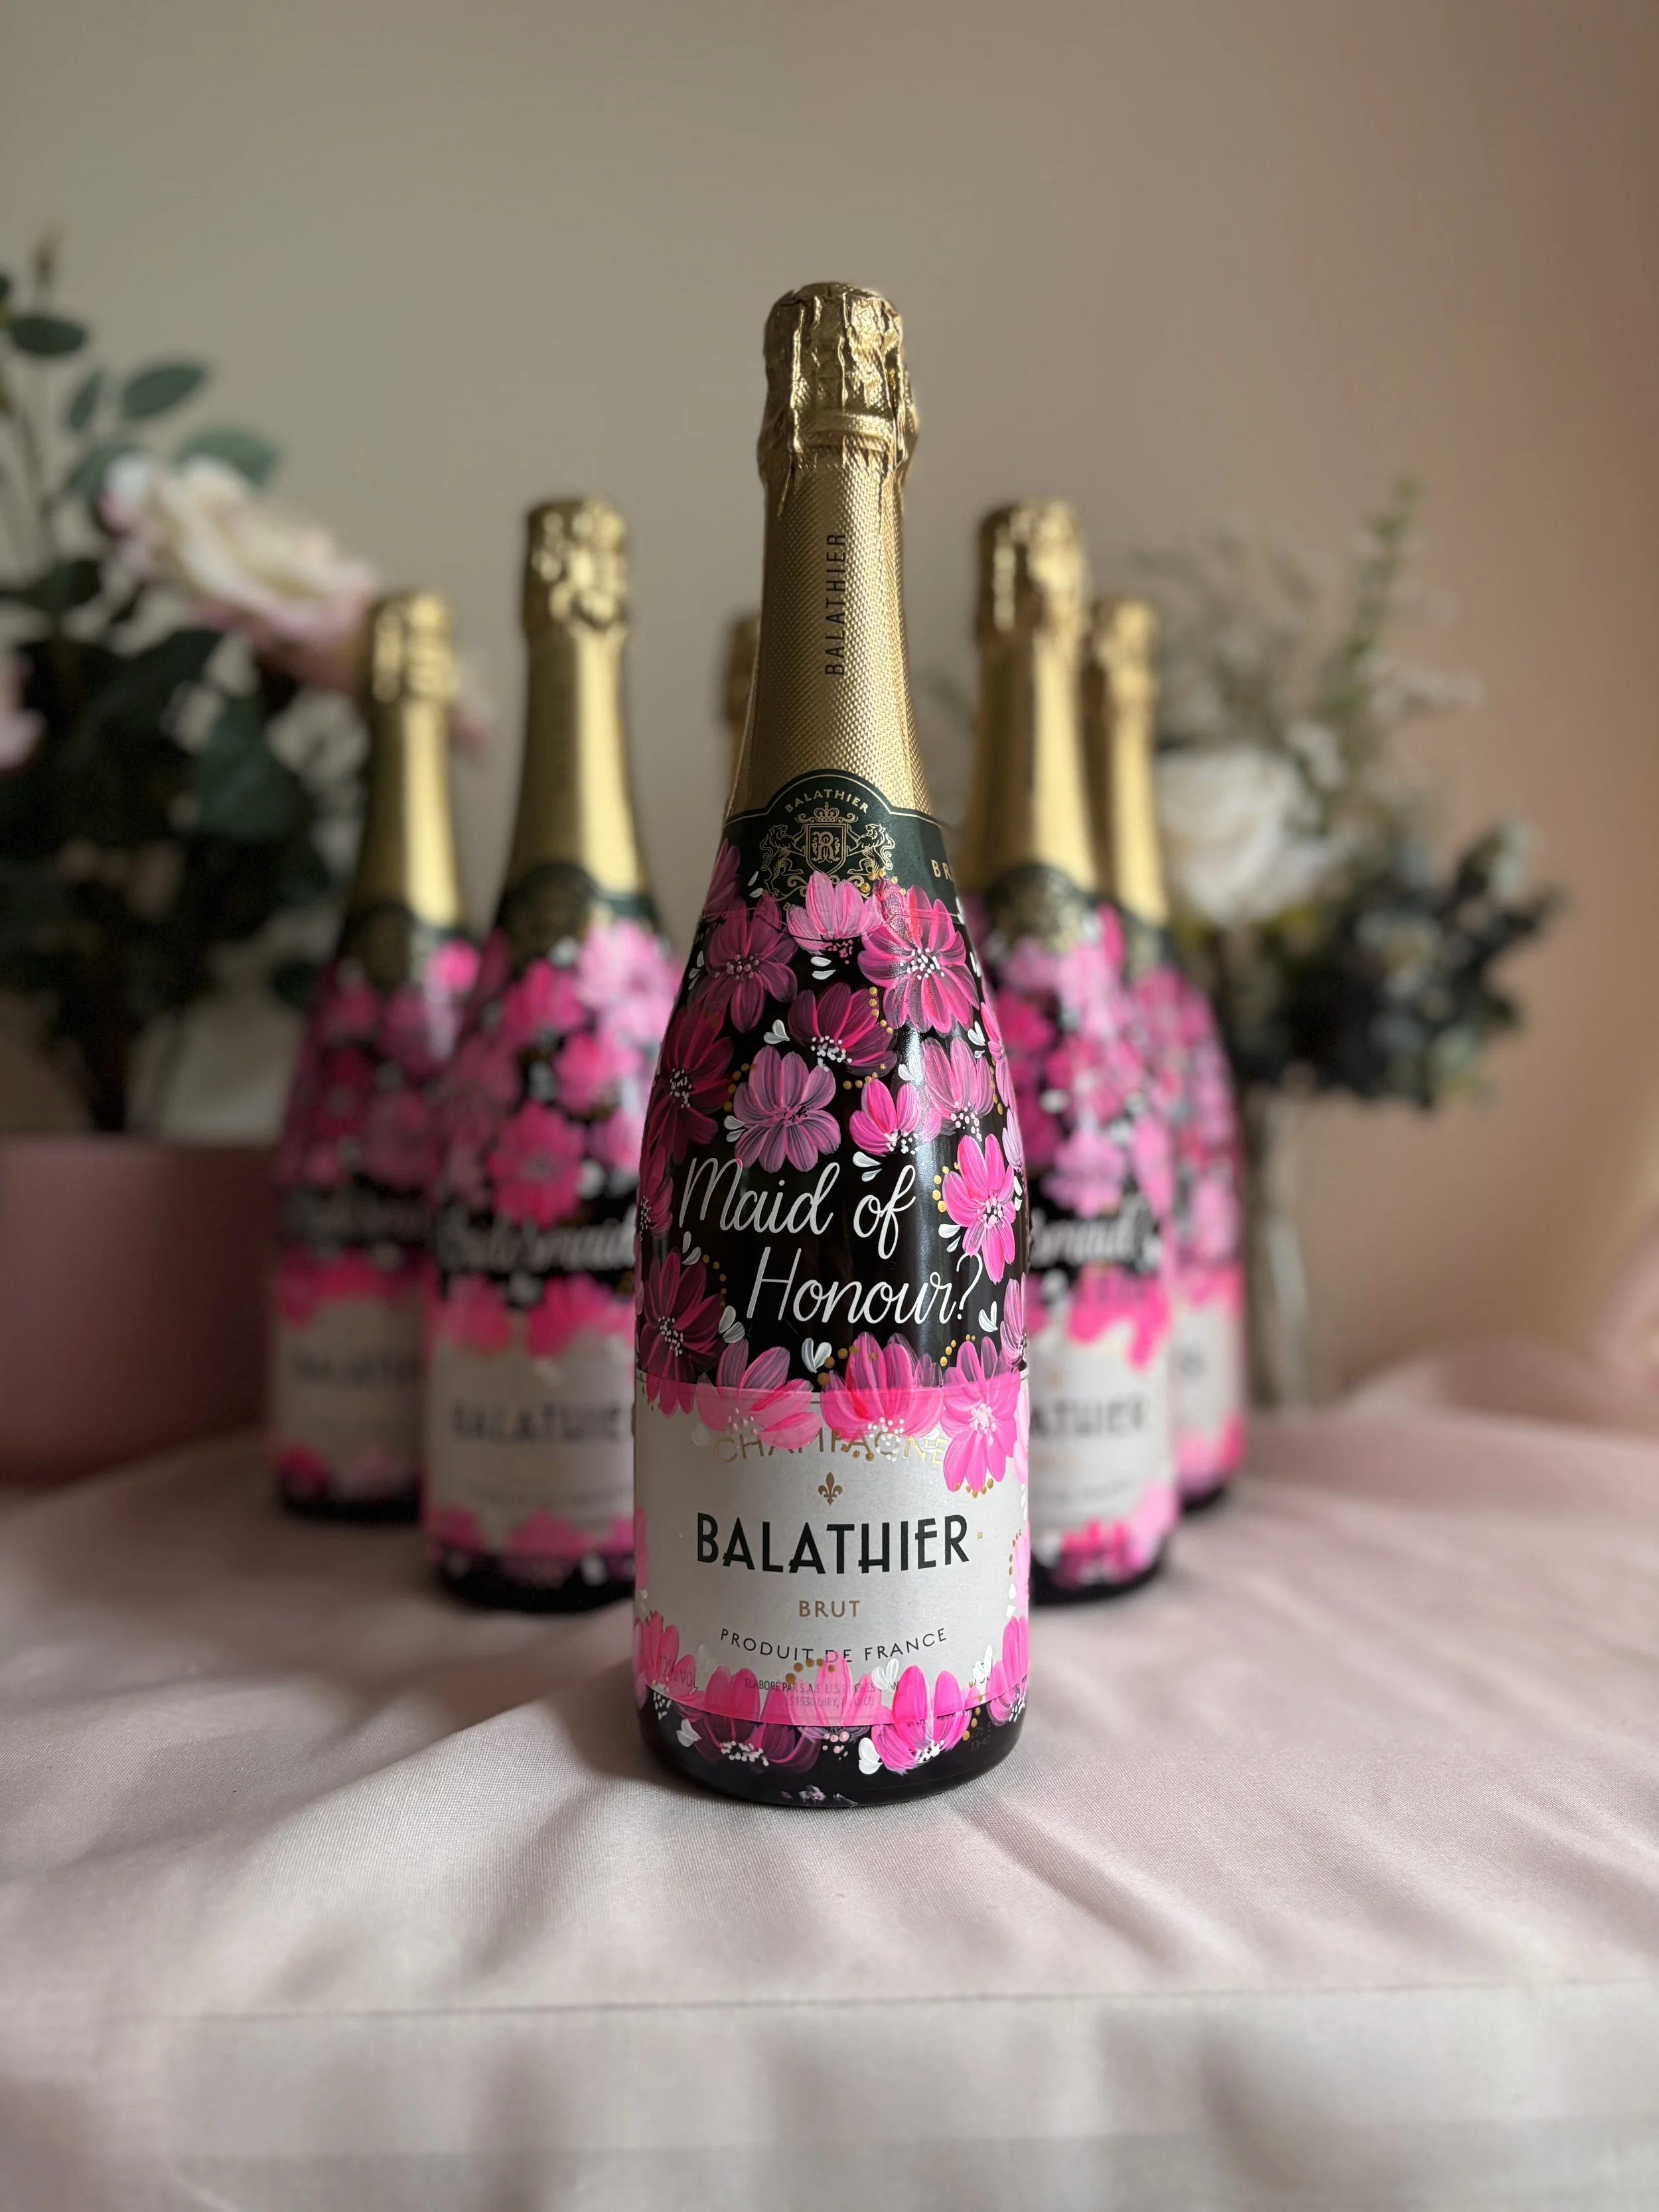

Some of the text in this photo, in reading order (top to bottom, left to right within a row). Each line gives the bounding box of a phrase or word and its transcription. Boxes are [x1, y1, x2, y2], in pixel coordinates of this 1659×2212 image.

[826, 533, 846, 676] BALATHIER
[784, 788, 869, 814] BALATHIER
[679, 1157, 916, 1259] Maid of
[747, 1246, 983, 1325] Honour?
[697, 1512, 970, 1575] BALATHIER
[798, 1599, 861, 1618] BRUT
[721, 1628, 947, 1662] PRODUIT DE FRANCE
